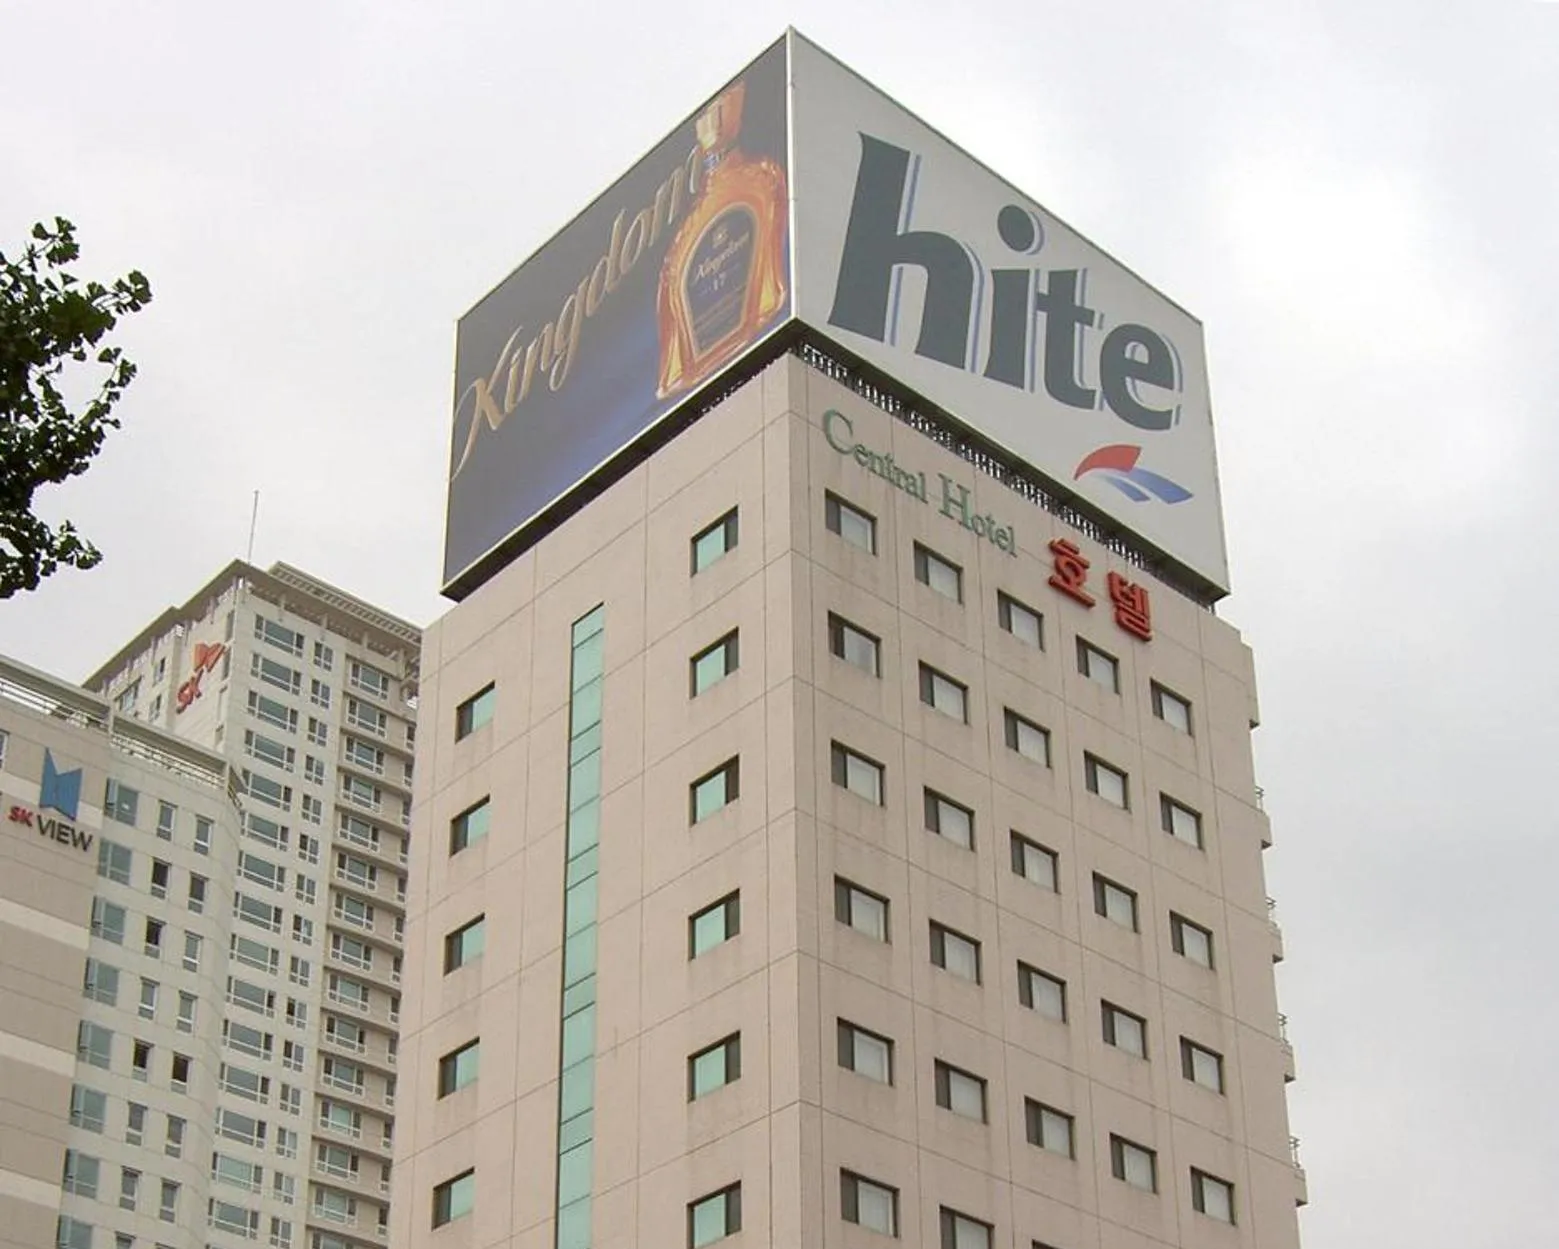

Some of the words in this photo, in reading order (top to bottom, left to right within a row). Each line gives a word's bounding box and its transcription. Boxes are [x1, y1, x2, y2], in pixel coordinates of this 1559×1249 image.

[827, 131, 1182, 430] hite
[823, 409, 928, 504] Central
[938, 472, 1017, 558] Hotel
[1048, 537, 1153, 642] 호텔
[8, 806, 33, 828] SK
[36, 814, 93, 852] VIEW
